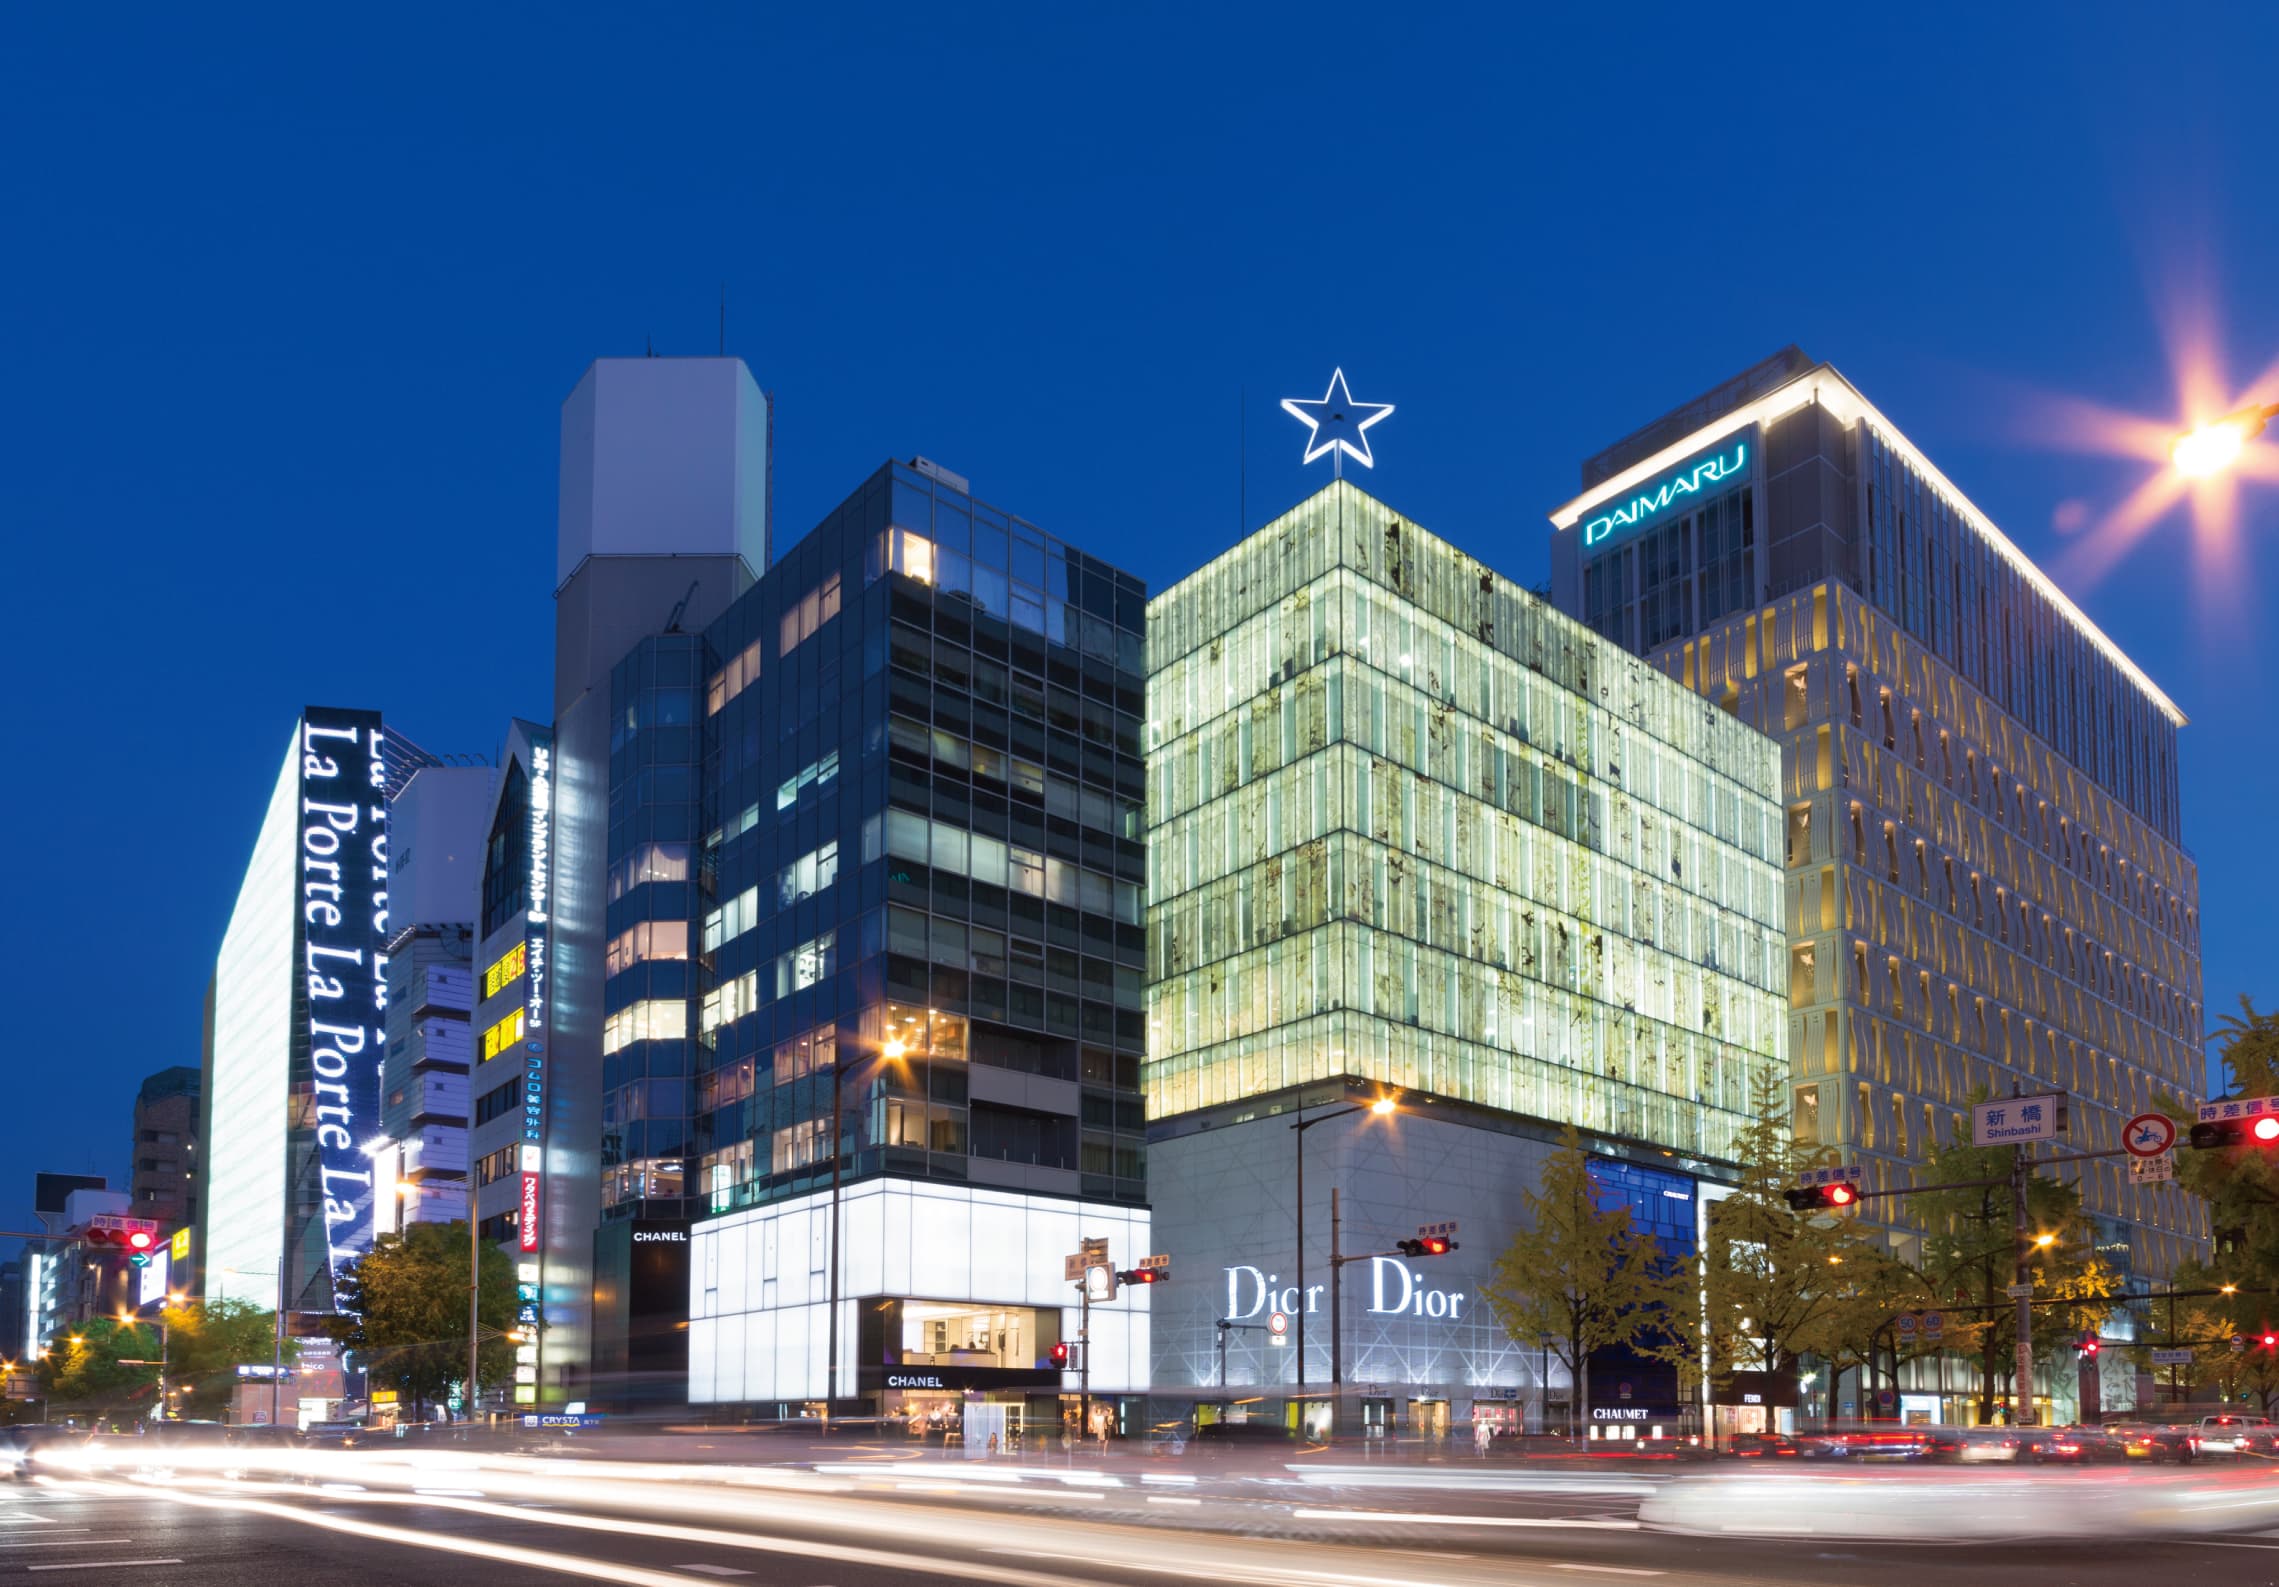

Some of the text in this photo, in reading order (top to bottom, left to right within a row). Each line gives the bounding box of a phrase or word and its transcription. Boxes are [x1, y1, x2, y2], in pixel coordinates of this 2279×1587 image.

[1585, 445, 1745, 546] DAIMARU
[304, 722, 358, 780] La
[304, 798, 360, 927] Porte
[307, 942, 362, 1000] La
[311, 1018, 364, 1150] Porte
[525, 1058, 543, 1140] コムロ美容外科
[2200, 1098, 2279, 1120] 時差信号
[1985, 1104, 2042, 1127] 新橋
[1986, 1124, 2041, 1139] Shinbashi
[322, 1164, 371, 1222] La
[633, 1231, 687, 1242] CHANEL
[1366, 1256, 1465, 1319] Dior
[888, 1375, 943, 1388] CHANEL
[542, 1416, 580, 1424] CRYSTA
[1593, 1408, 1649, 1420] CHAUMET
